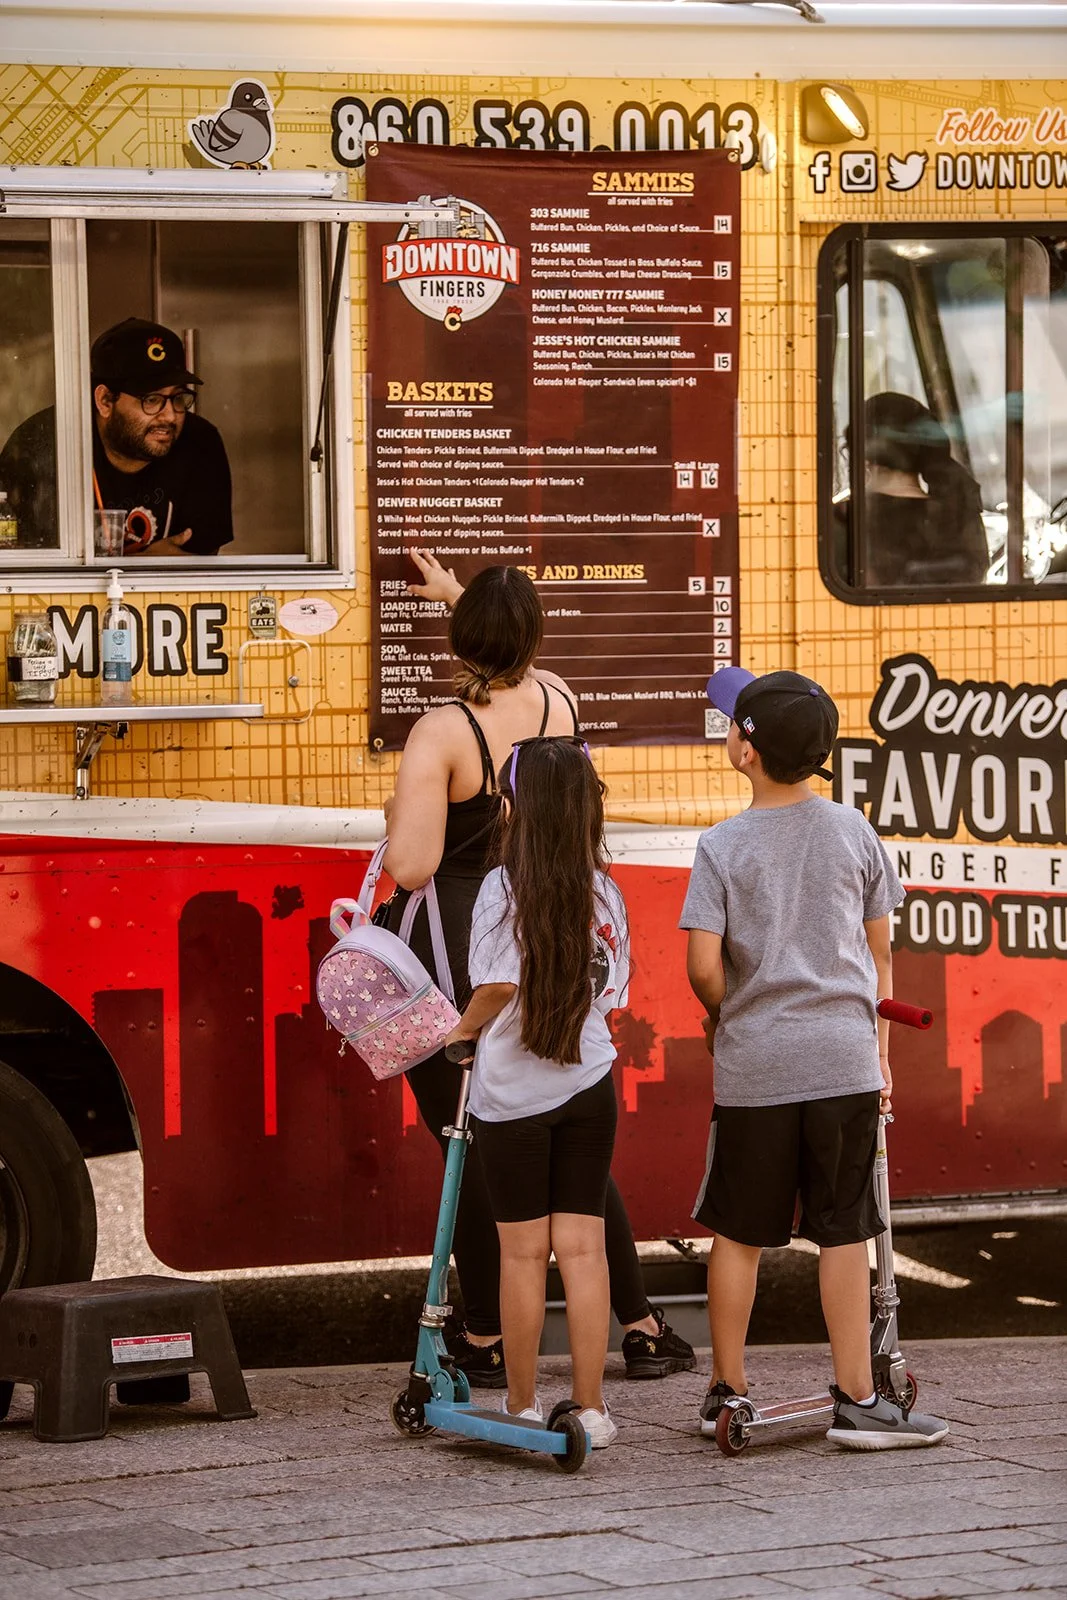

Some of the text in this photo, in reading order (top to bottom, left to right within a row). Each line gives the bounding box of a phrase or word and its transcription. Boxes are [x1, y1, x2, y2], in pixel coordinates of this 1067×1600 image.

[938, 109, 1067, 143] Follow Us
[337, 104, 754, 162] 8605390013
[938, 154, 1067, 188] DOWNTOW
[592, 172, 694, 192] SAMMIES
[530, 208, 589, 218] 303 SAMMIE
[717, 219, 728, 231] 14
[531, 243, 590, 253] 716 SAMMIE
[385, 242, 517, 282] DOWNTOWN
[717, 265, 728, 277] 15
[420, 280, 485, 298] FINGERS
[532, 290, 664, 299] HONEY MONEY 777 SAMMIE
[718, 312, 727, 323] X
[533, 336, 680, 346] JESSE'S HOT CHICKEN SAMMIE
[718, 357, 729, 368] 15
[387, 381, 493, 402] BASKETS
[376, 429, 511, 438] CHICKEN TENDERS BASKET
[674, 461, 719, 470] Small Large
[679, 472, 716, 485] 14 16
[378, 498, 502, 507] DENVER NUGGET BASKET
[706, 522, 715, 535] X
[542, 566, 577, 579] AND
[583, 565, 644, 579] DRINKS
[380, 581, 407, 590] FRIES
[692, 580, 725, 592] 5 7
[380, 602, 446, 611] LOADED FRIES
[715, 601, 729, 612] 10
[380, 624, 413, 633] WATER
[717, 622, 727, 633] 2
[52, 608, 223, 672] MORE
[381, 645, 407, 654] SODA
[717, 643, 727, 654] 2
[381, 667, 432, 675] SWEET TEA
[381, 688, 417, 697] SAUCES
[878, 662, 1067, 739] Denver
[841, 747, 1067, 836] FAVOR
[898, 851, 1007, 884] NGER
[890, 899, 983, 947] FOOD
